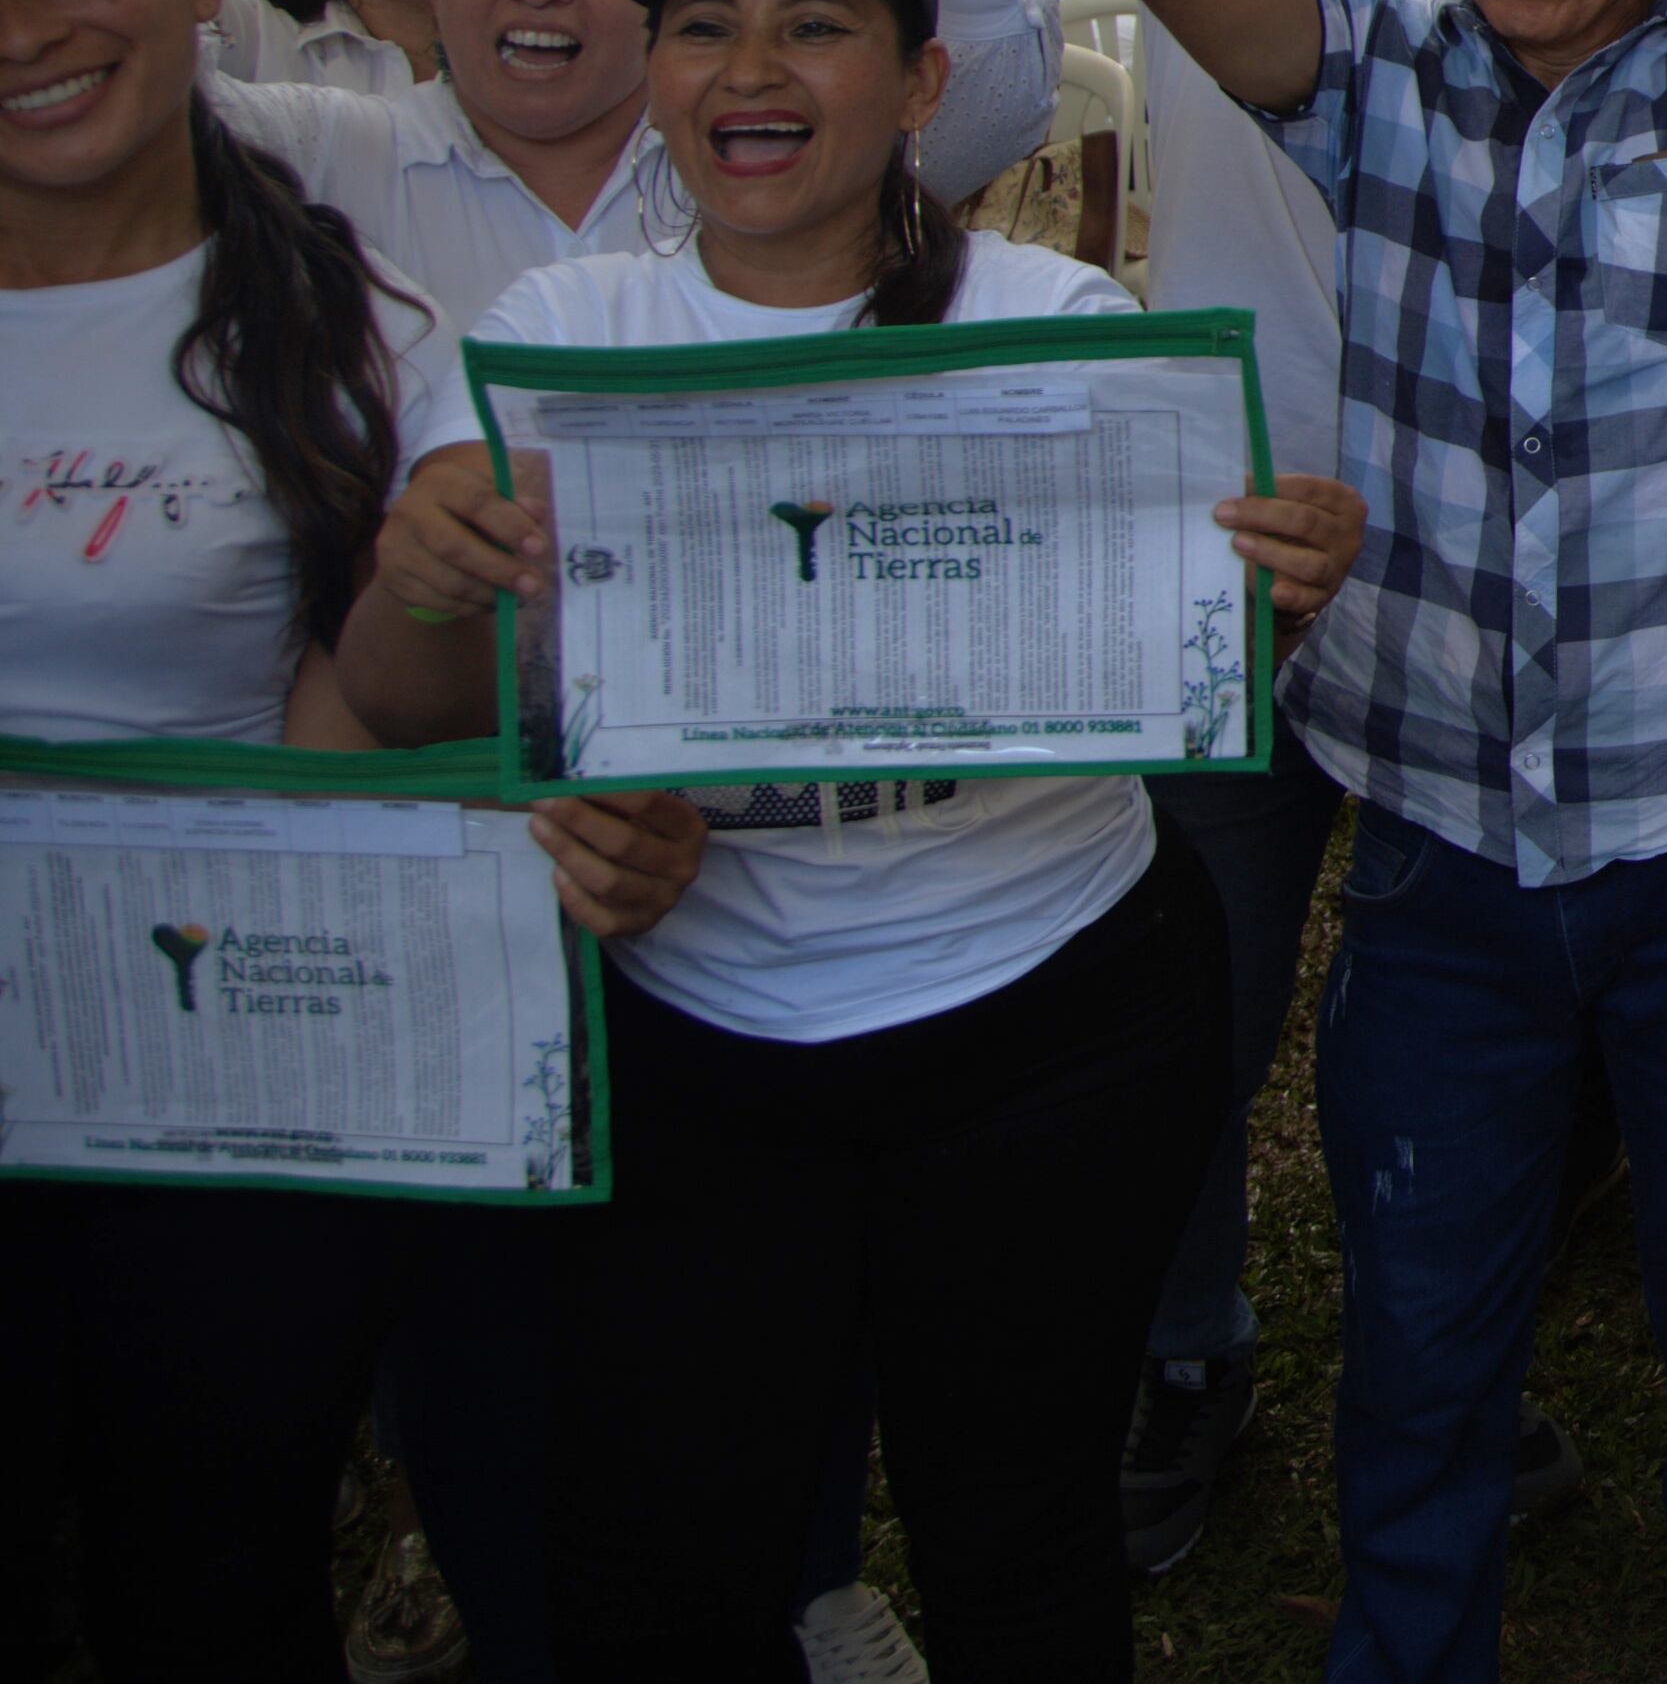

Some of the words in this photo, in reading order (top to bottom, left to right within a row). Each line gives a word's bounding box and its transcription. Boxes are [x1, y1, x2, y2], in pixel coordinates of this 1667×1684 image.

[1000, 386, 1044, 398] NOMBRE
[846, 497, 998, 518] Agencia
[848, 519, 1012, 547] Nacional
[1018, 527, 1043, 546] de
[848, 552, 981, 581] Tierras
[682, 726, 729, 742] Línea
[732, 724, 806, 741] Nacional
[834, 720, 908, 738] Atención
[1021, 720, 1040, 735] 01
[1042, 719, 1084, 734] 8000
[1086, 718, 1143, 734] 933881
[217, 926, 351, 955] Agencia
[219, 957, 366, 986] Nacional
[370, 971, 394, 986] de
[220, 987, 341, 1015] Tierras
[381, 1147, 400, 1163] 01
[400, 1148, 437, 1165] 8000
